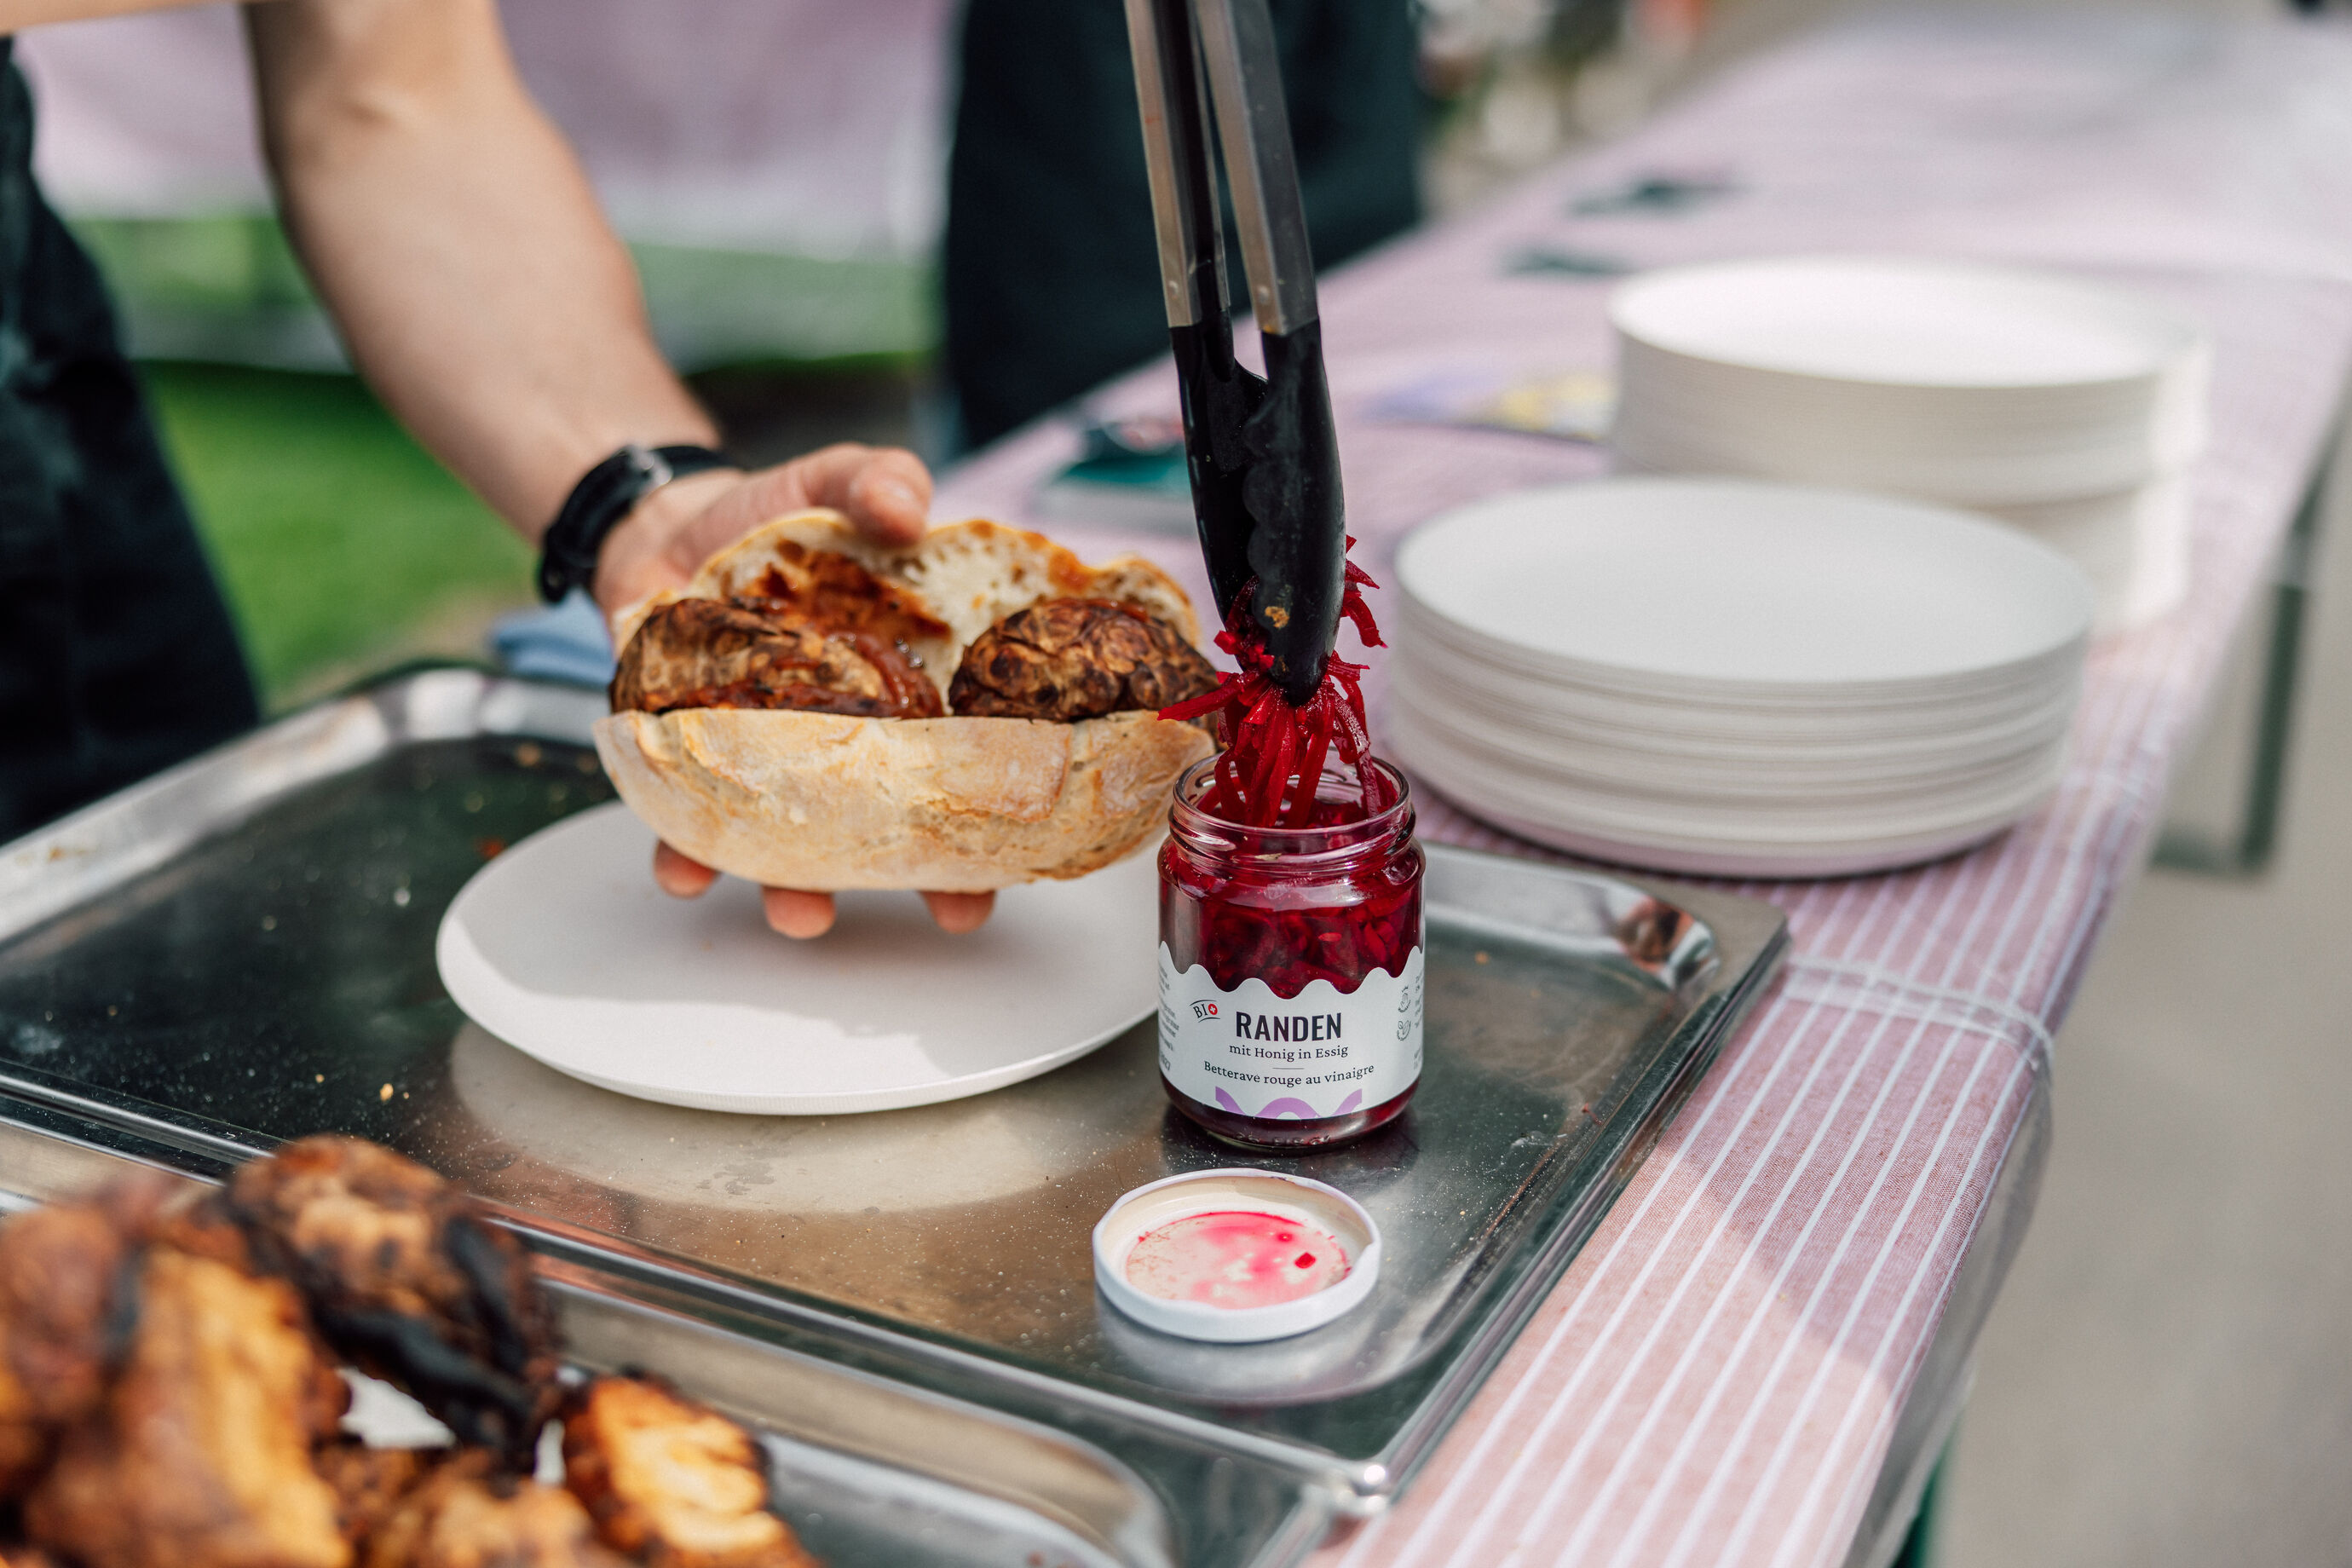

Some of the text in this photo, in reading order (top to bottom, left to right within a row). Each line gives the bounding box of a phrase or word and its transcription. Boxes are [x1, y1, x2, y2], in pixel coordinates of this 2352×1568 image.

[1236, 1011, 1341, 1041] RANDEN
[1229, 1045, 1348, 1062] mit Honig in Essig
[1204, 1061, 1375, 1087] Betterave rouge au vinaigre
